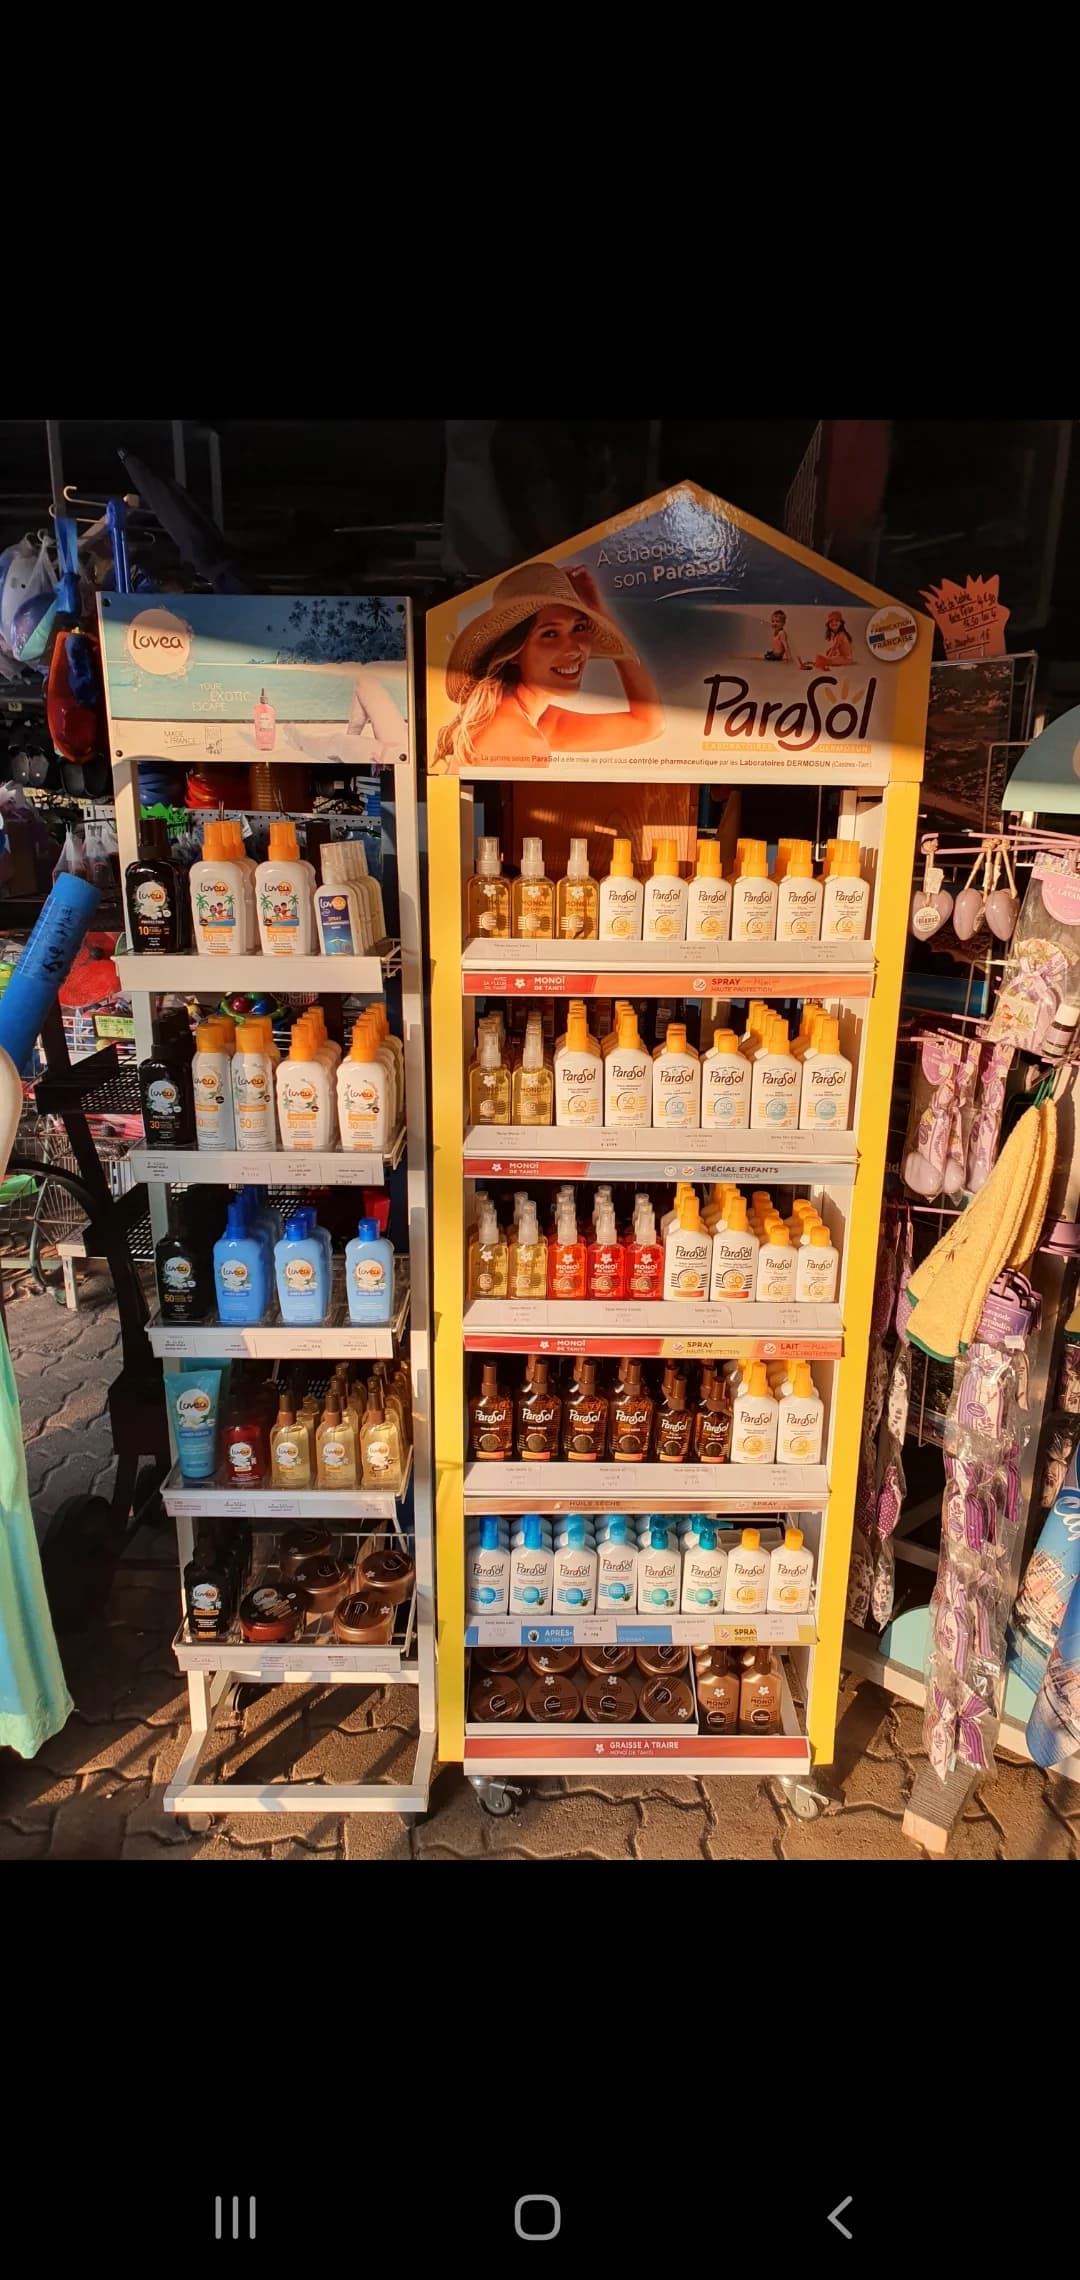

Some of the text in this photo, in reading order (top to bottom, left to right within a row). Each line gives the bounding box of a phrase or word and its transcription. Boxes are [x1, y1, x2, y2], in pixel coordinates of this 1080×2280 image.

[597, 553, 611, 568] A
[617, 541, 686, 564] chaque
[614, 559, 728, 588] son ParaSol
[870, 619, 912, 633] FABRICATION
[132, 629, 184, 650] lovea
[872, 633, 913, 650] FRANÇAISE
[210, 690, 249, 702] EXOTIC
[704, 674, 877, 751] ParaSol
[531, 755, 560, 763] ParaSol
[660, 758, 718, 767] pharmaceutique
[740, 759, 784, 767] Laboratoires
[609, 889, 637, 902] ParaSol
[653, 889, 681, 902] ParaSol
[698, 890, 727, 903] ParaSol
[744, 891, 772, 904] ParaSol
[788, 891, 817, 904] ParaSol
[835, 890, 864, 903] ParaSol
[138, 926, 149, 935] 10
[534, 975, 565, 984] MONOÏ
[562, 1068, 596, 1083] ParaSol
[612, 1065, 646, 1080] ParaSol
[660, 1070, 694, 1085] ParaSol
[710, 1071, 744, 1086] ParaSol
[762, 1072, 797, 1086] ParaSol
[811, 1071, 846, 1086] ParaSol
[150, 1121, 160, 1129] 30
[739, 1166, 778, 1174] ENFANTS
[675, 1245, 707, 1259] ParaSol
[720, 1246, 752, 1259] ParaSol
[766, 1258, 792, 1271] ParaSol
[806, 1258, 833, 1271] ParaSol
[164, 1295, 174, 1303] 50
[475, 1409, 506, 1423] ParaSol
[522, 1408, 554, 1423] ParaSol
[569, 1409, 601, 1424] ParaSol
[615, 1409, 647, 1423] ParaSol
[740, 1411, 773, 1426] ParaSol
[786, 1412, 819, 1426] ParaSol
[661, 1418, 687, 1432] ParaSol
[703, 1420, 730, 1433] ParaSol
[473, 1563, 505, 1576] ParaSol
[516, 1562, 548, 1576] ParaSol
[559, 1563, 591, 1577] ParaSol
[602, 1558, 634, 1572] ParaSol
[644, 1564, 676, 1577] ParaSol
[690, 1564, 723, 1578] ParaSol
[734, 1563, 766, 1577] ParaSol
[777, 1563, 809, 1577] ParaSol
[610, 1741, 642, 1749] GRAISSE
[643, 1740, 650, 1749] À
